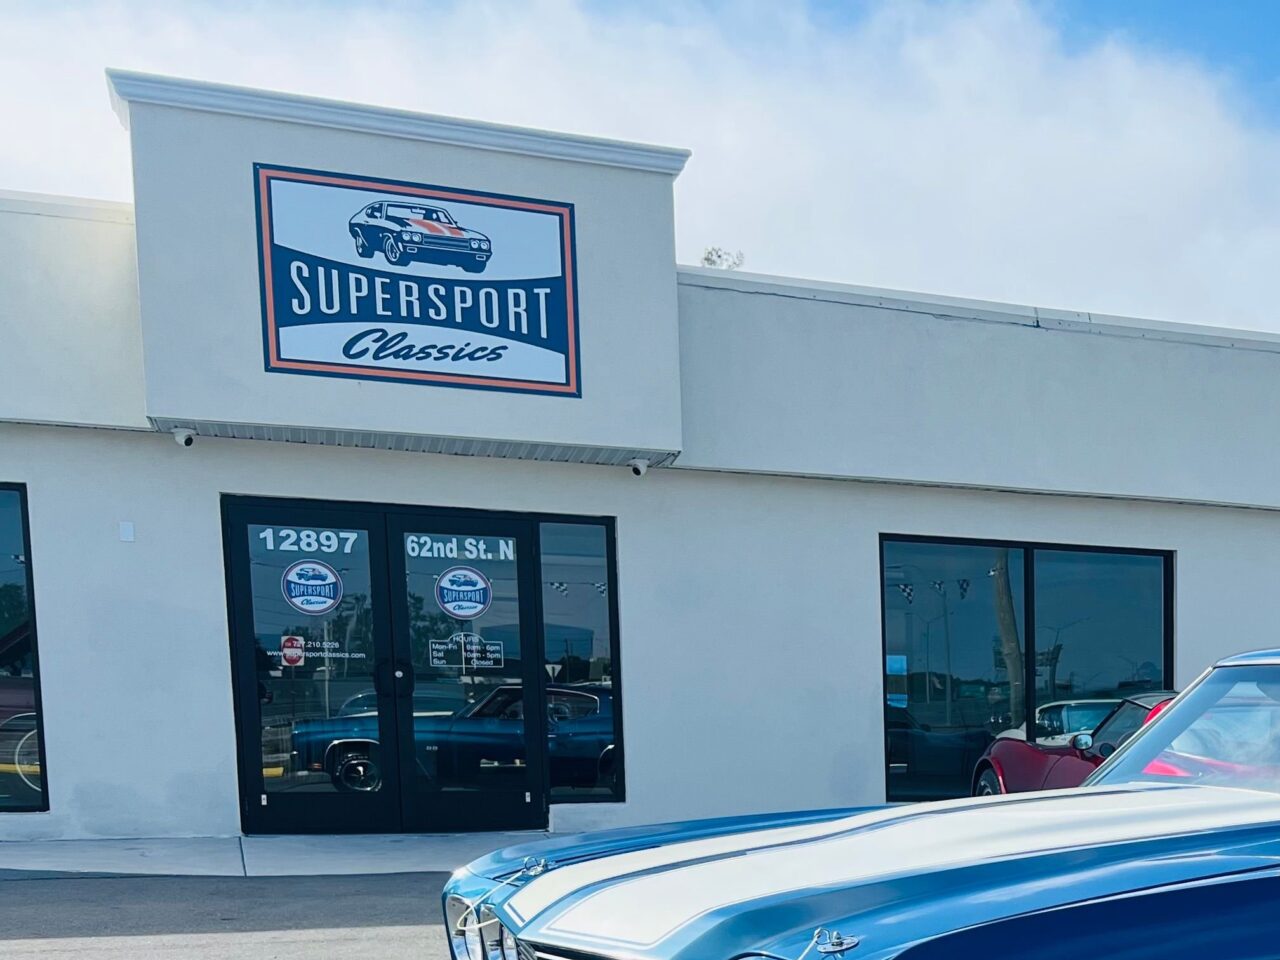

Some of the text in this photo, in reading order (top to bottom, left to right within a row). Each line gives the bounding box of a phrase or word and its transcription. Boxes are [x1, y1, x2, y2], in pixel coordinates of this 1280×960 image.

[290, 260, 551, 339] SUPERSPORT
[342, 327, 509, 362] Classics
[260, 528, 358, 554] 12897
[406, 535, 514, 560] 62nd St. N
[291, 583, 334, 598] SUPERSPORT
[443, 589, 484, 603] SUPERSPORT
[432, 650, 444, 658] Sat
